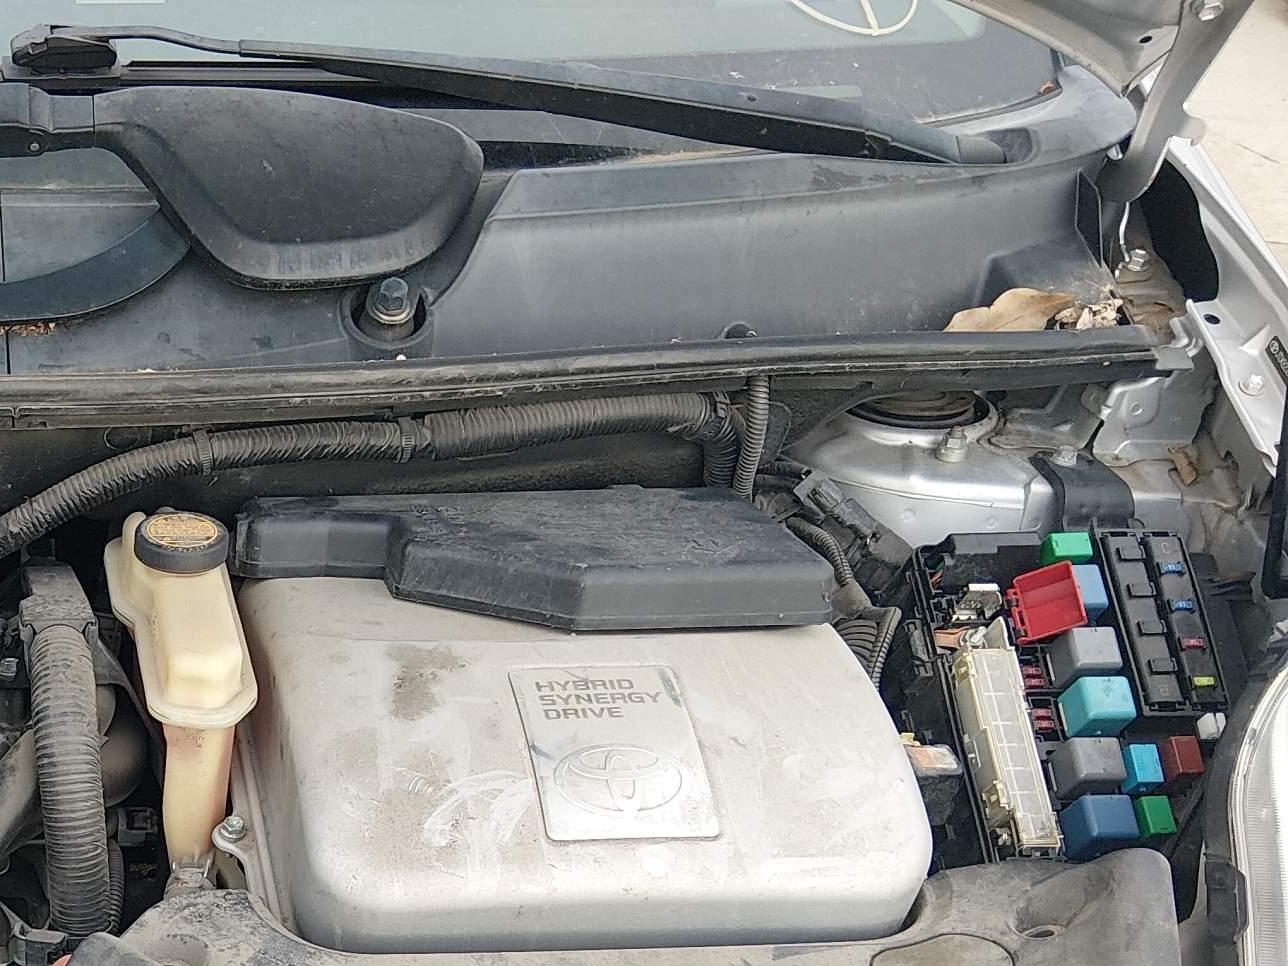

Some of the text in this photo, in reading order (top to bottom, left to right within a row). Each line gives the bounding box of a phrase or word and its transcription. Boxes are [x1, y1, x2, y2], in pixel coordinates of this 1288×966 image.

[535, 679, 634, 692] HYBRID
[540, 692, 661, 706] SYNERGY
[544, 707, 624, 720] DRIVE
